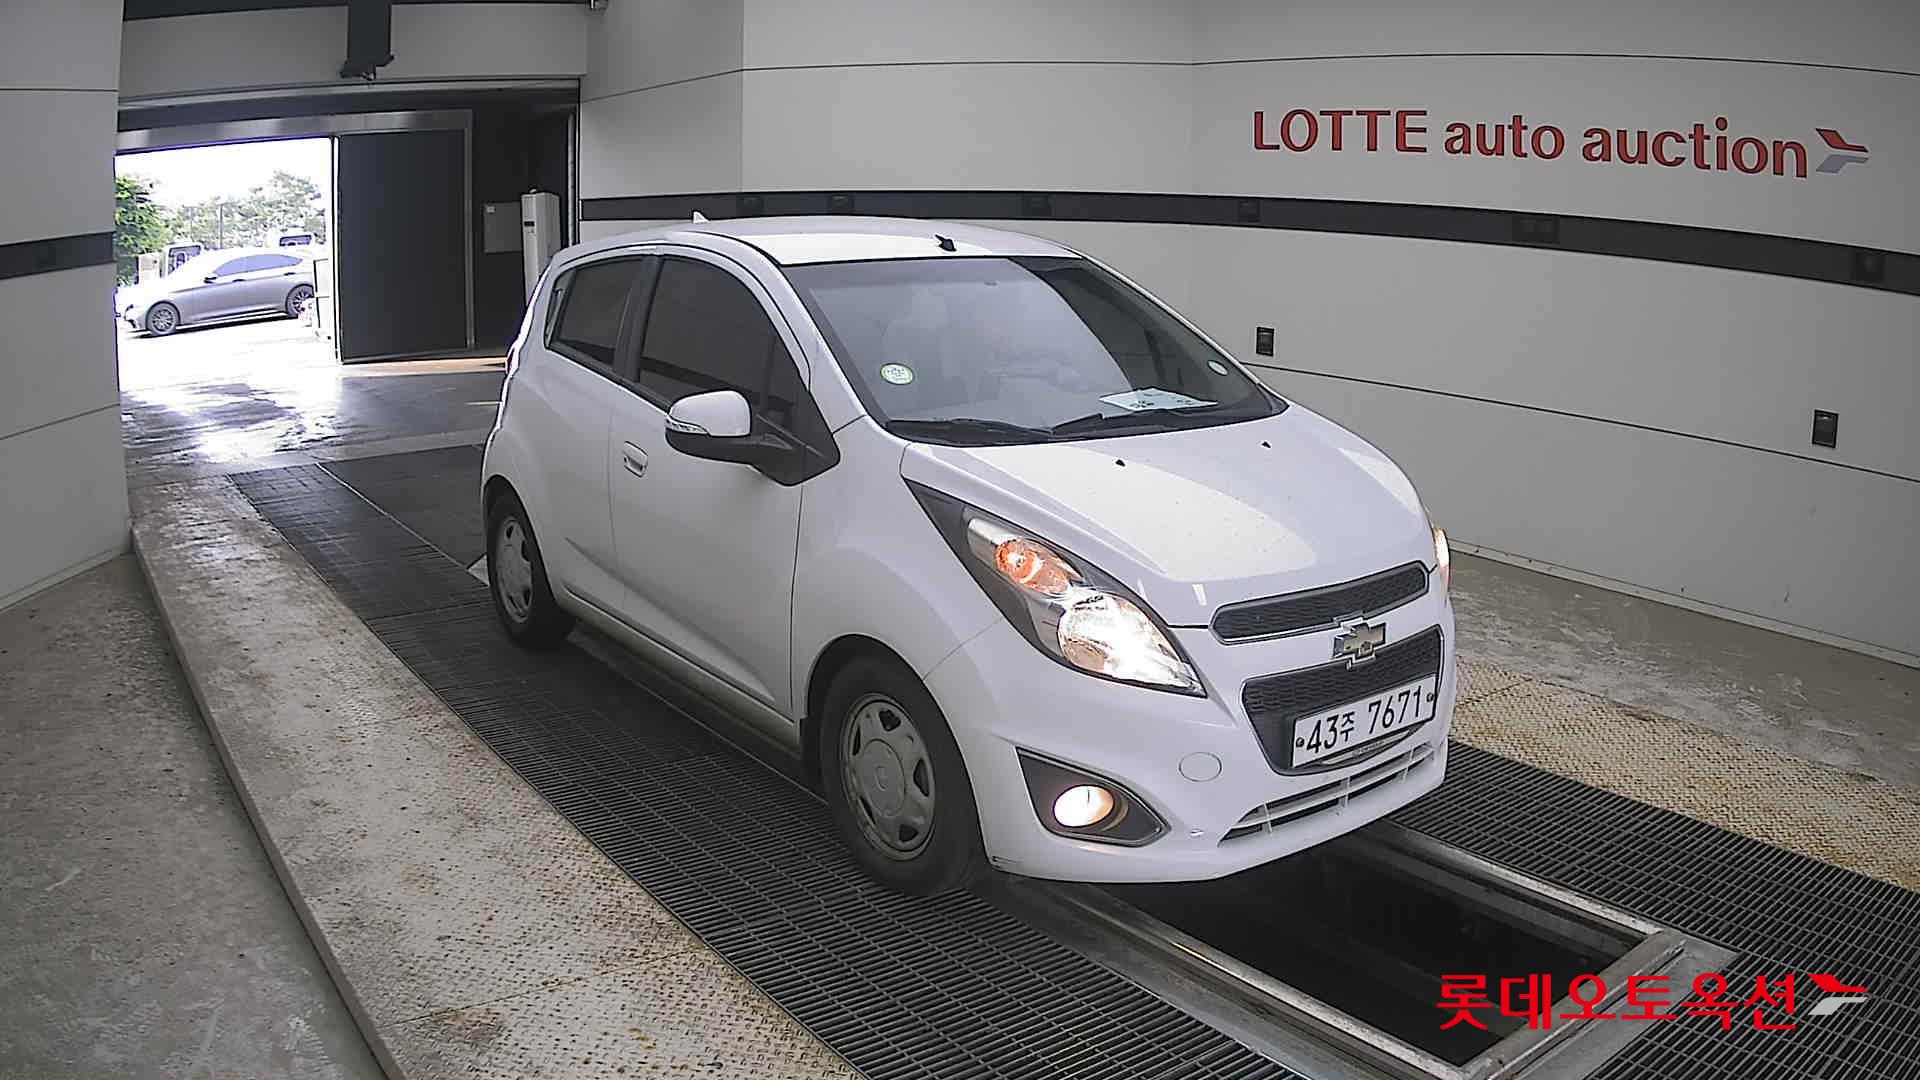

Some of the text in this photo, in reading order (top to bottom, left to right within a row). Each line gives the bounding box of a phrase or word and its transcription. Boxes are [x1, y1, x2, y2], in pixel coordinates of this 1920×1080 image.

[1253, 109, 1808, 178] LOTTE auto auction
[1306, 685, 1422, 754] 43주 7671
